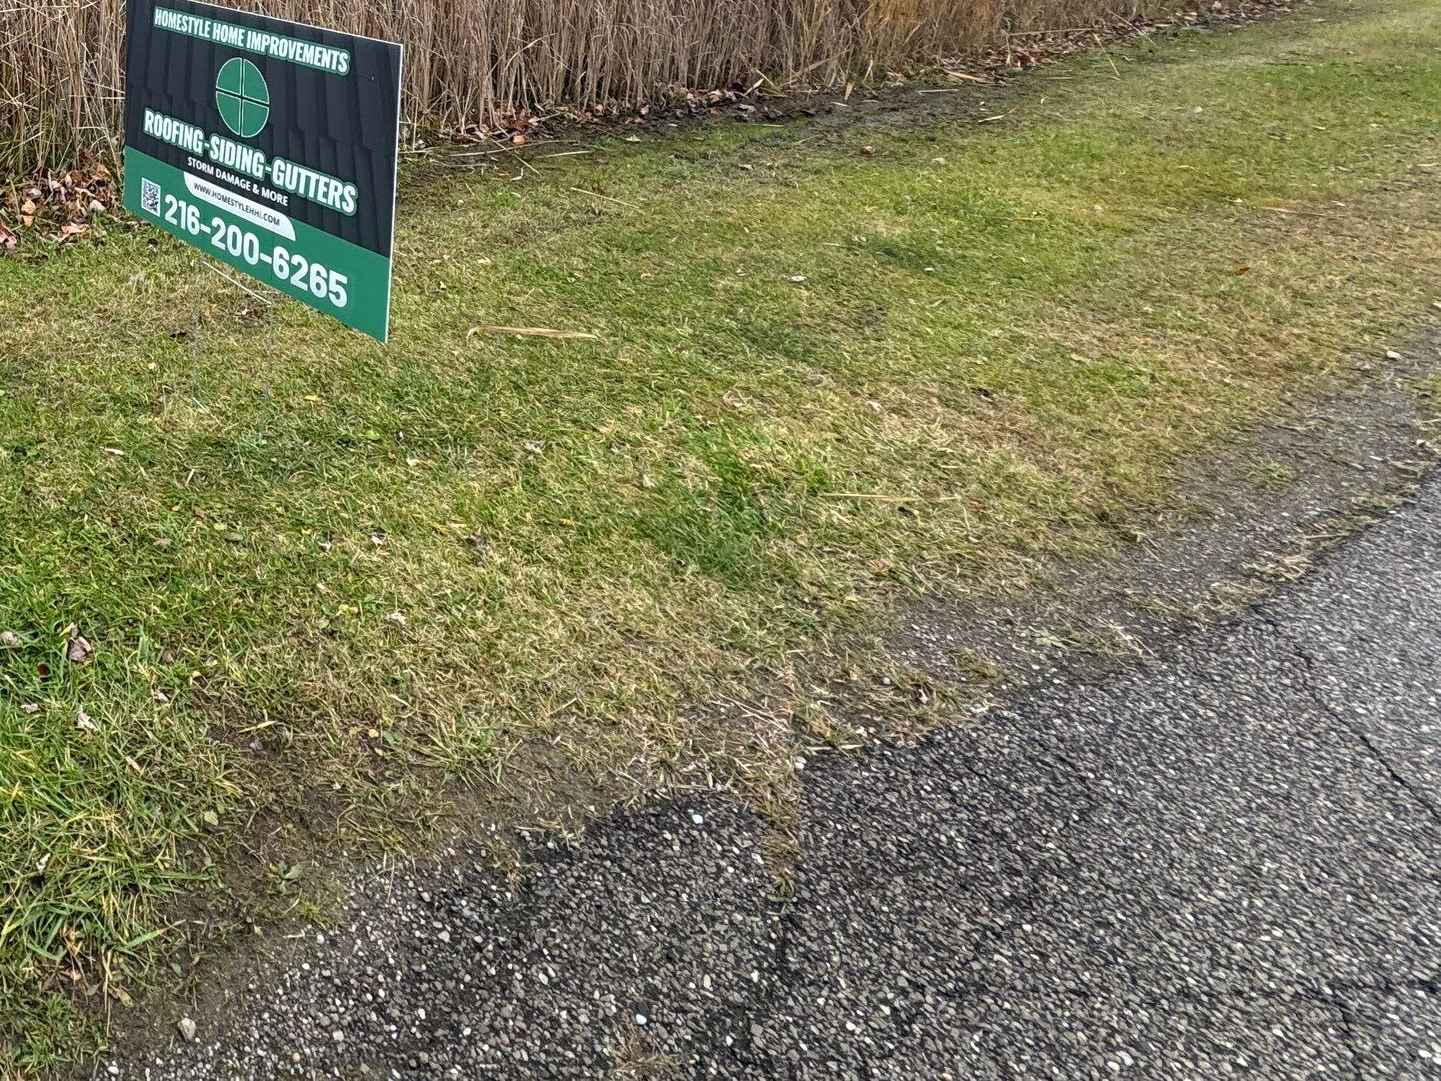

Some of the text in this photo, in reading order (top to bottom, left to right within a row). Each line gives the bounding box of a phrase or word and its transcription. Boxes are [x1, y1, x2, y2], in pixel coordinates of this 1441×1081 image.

[154, 8, 349, 72] HOMESTYLE HOME IMPROVEMENTS
[187, 156, 289, 207] STORM DAMAGE & MORE
[164, 194, 349, 308] 216-200-6265
